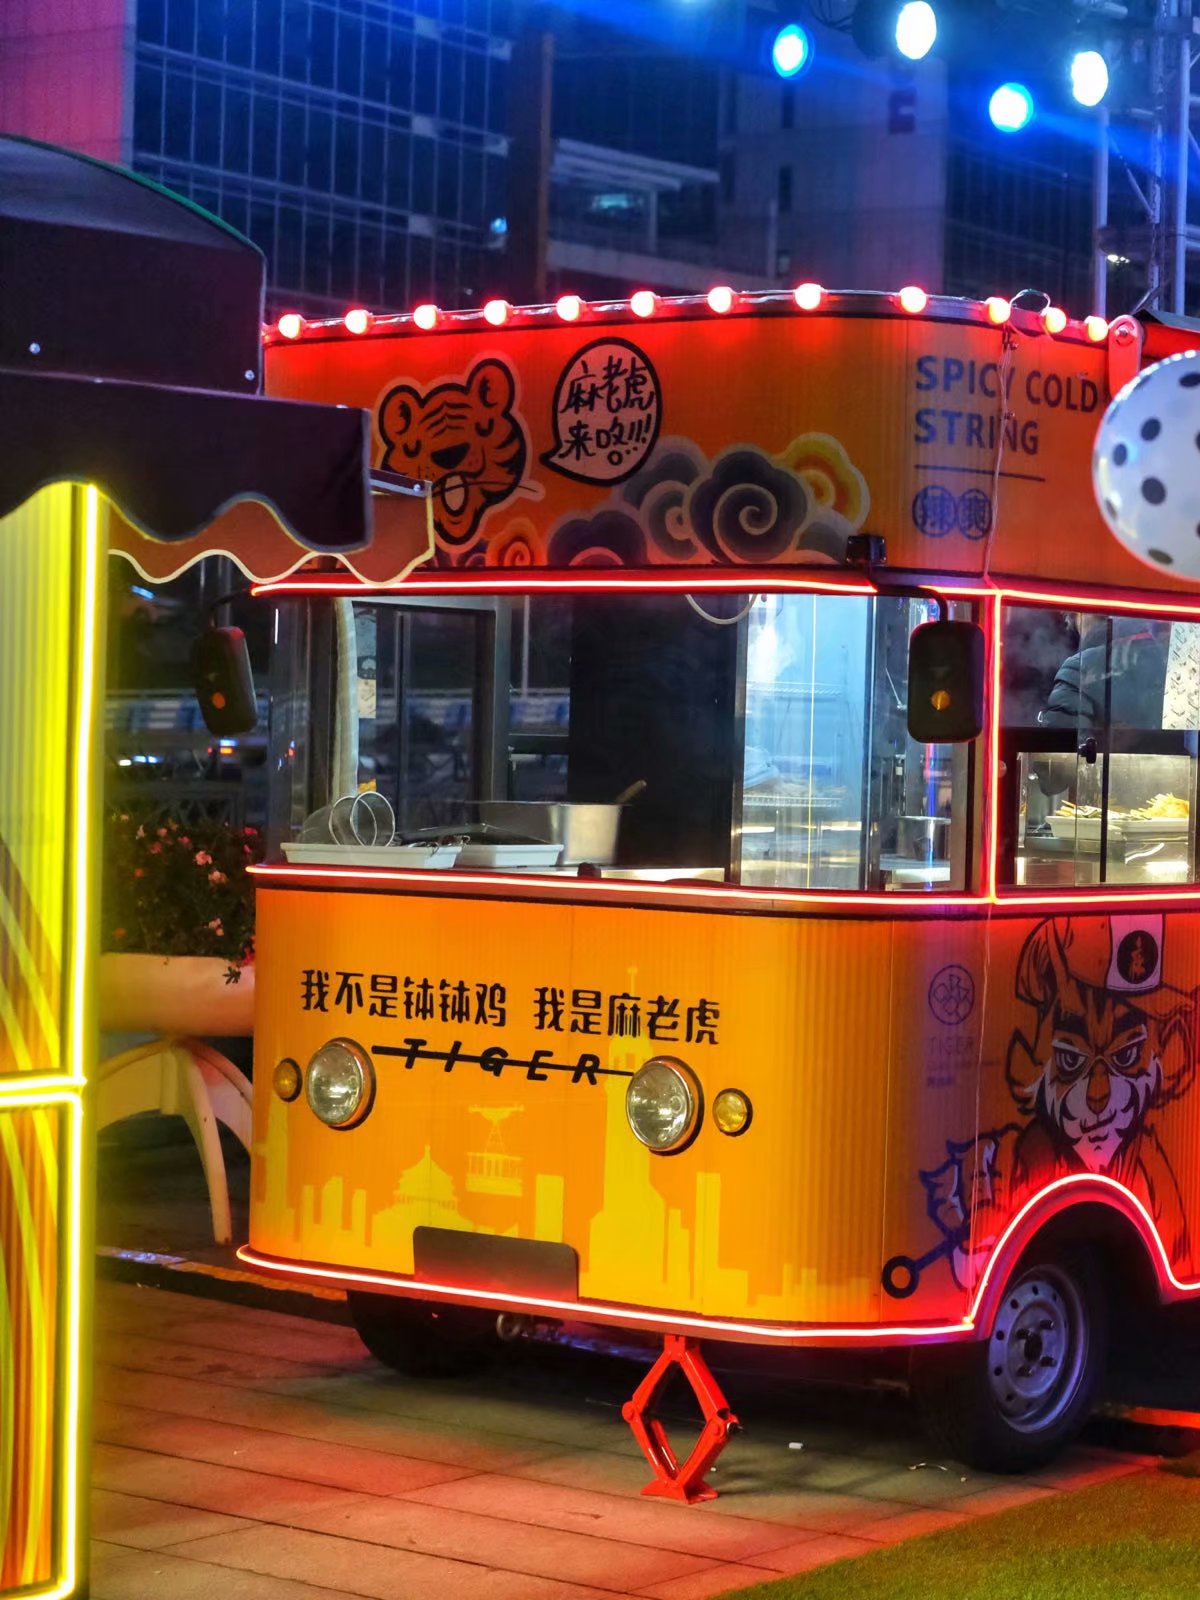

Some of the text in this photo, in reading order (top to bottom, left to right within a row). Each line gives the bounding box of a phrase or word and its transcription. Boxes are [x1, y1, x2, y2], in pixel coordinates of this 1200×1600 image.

[559, 355, 655, 414] 麻老虎
[916, 355, 1099, 413] SPICY COLD
[914, 408, 1039, 455] STRING
[301, 969, 720, 1045] 我不是钵钵鸡 我是麻老虎
[403, 1038, 600, 1086] TIGER
